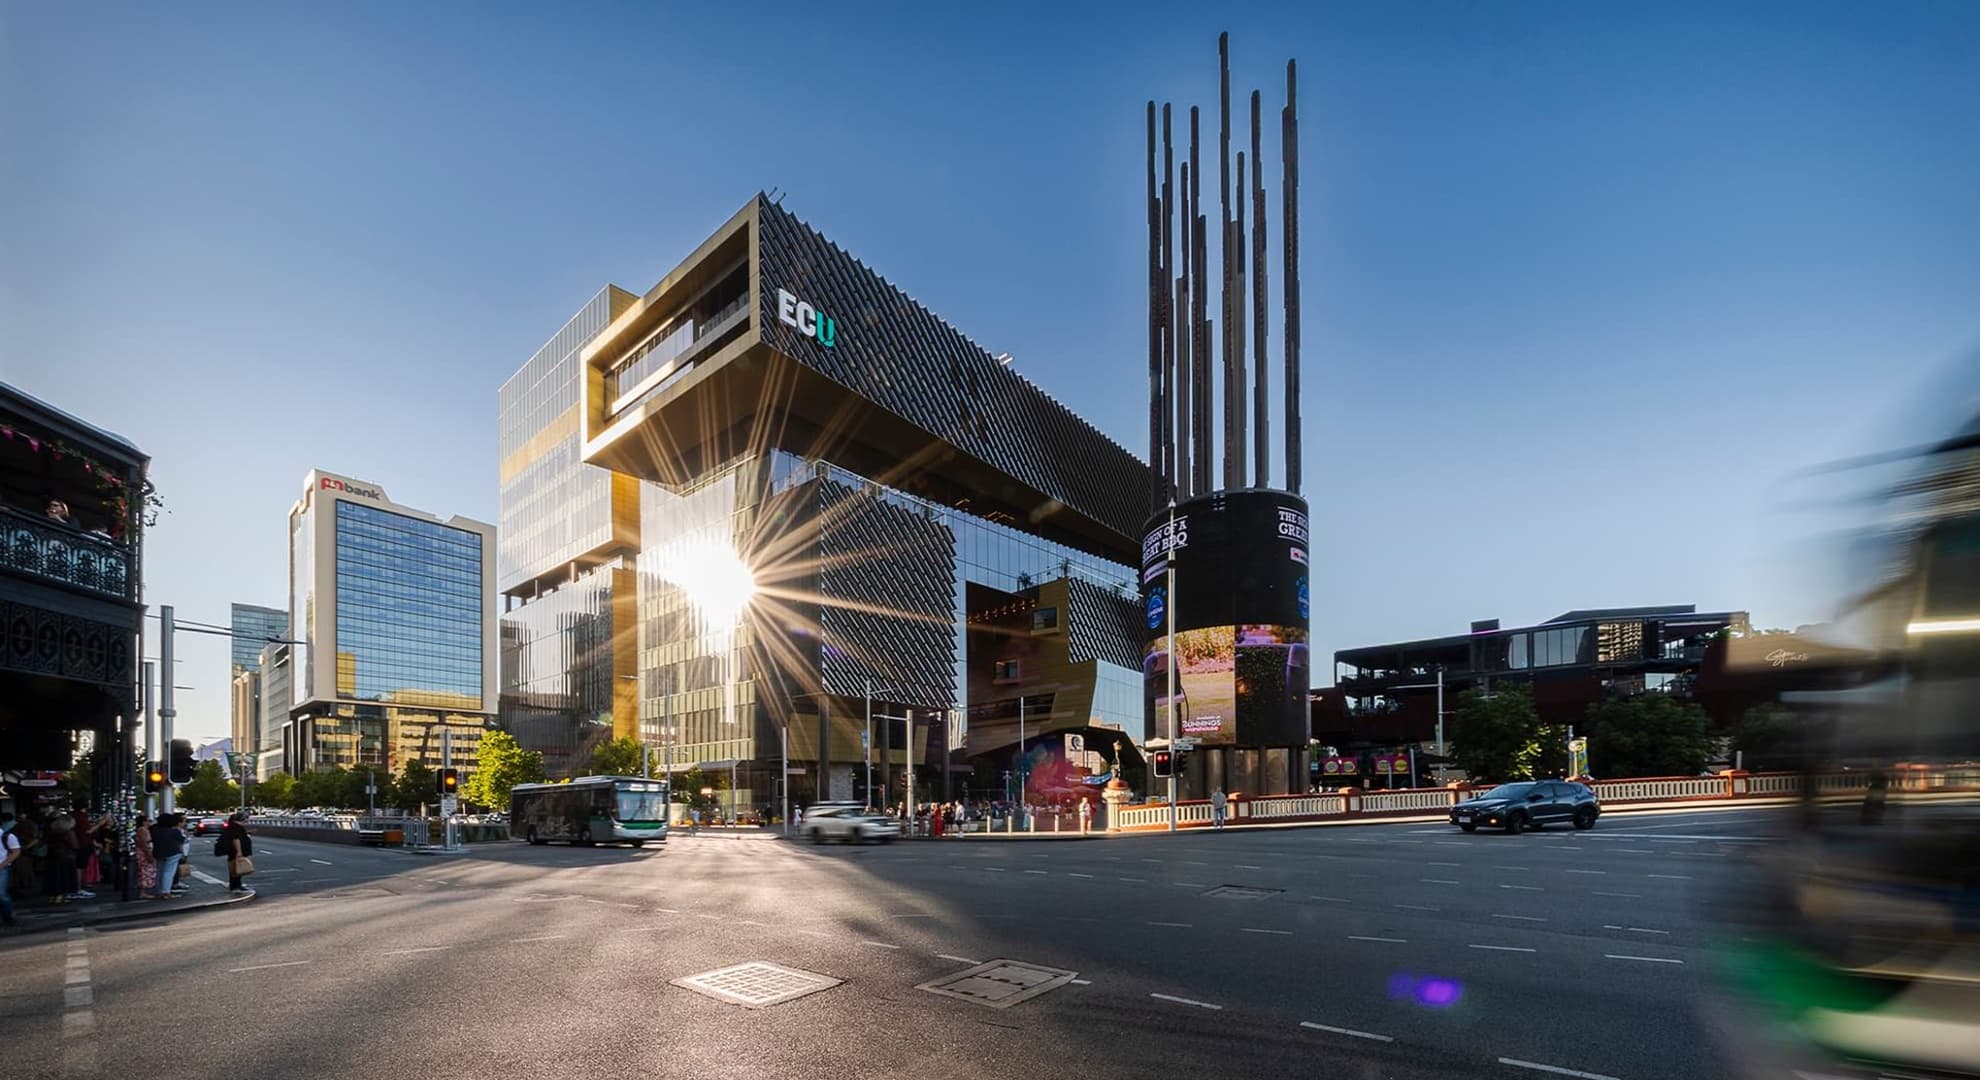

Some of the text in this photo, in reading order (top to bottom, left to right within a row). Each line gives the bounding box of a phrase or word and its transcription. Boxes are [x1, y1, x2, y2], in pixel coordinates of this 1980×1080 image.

[778, 288, 835, 347] ECU
[344, 483, 381, 500] bank
[1278, 510, 1297, 524] THE
[1178, 520, 1187, 531] A
